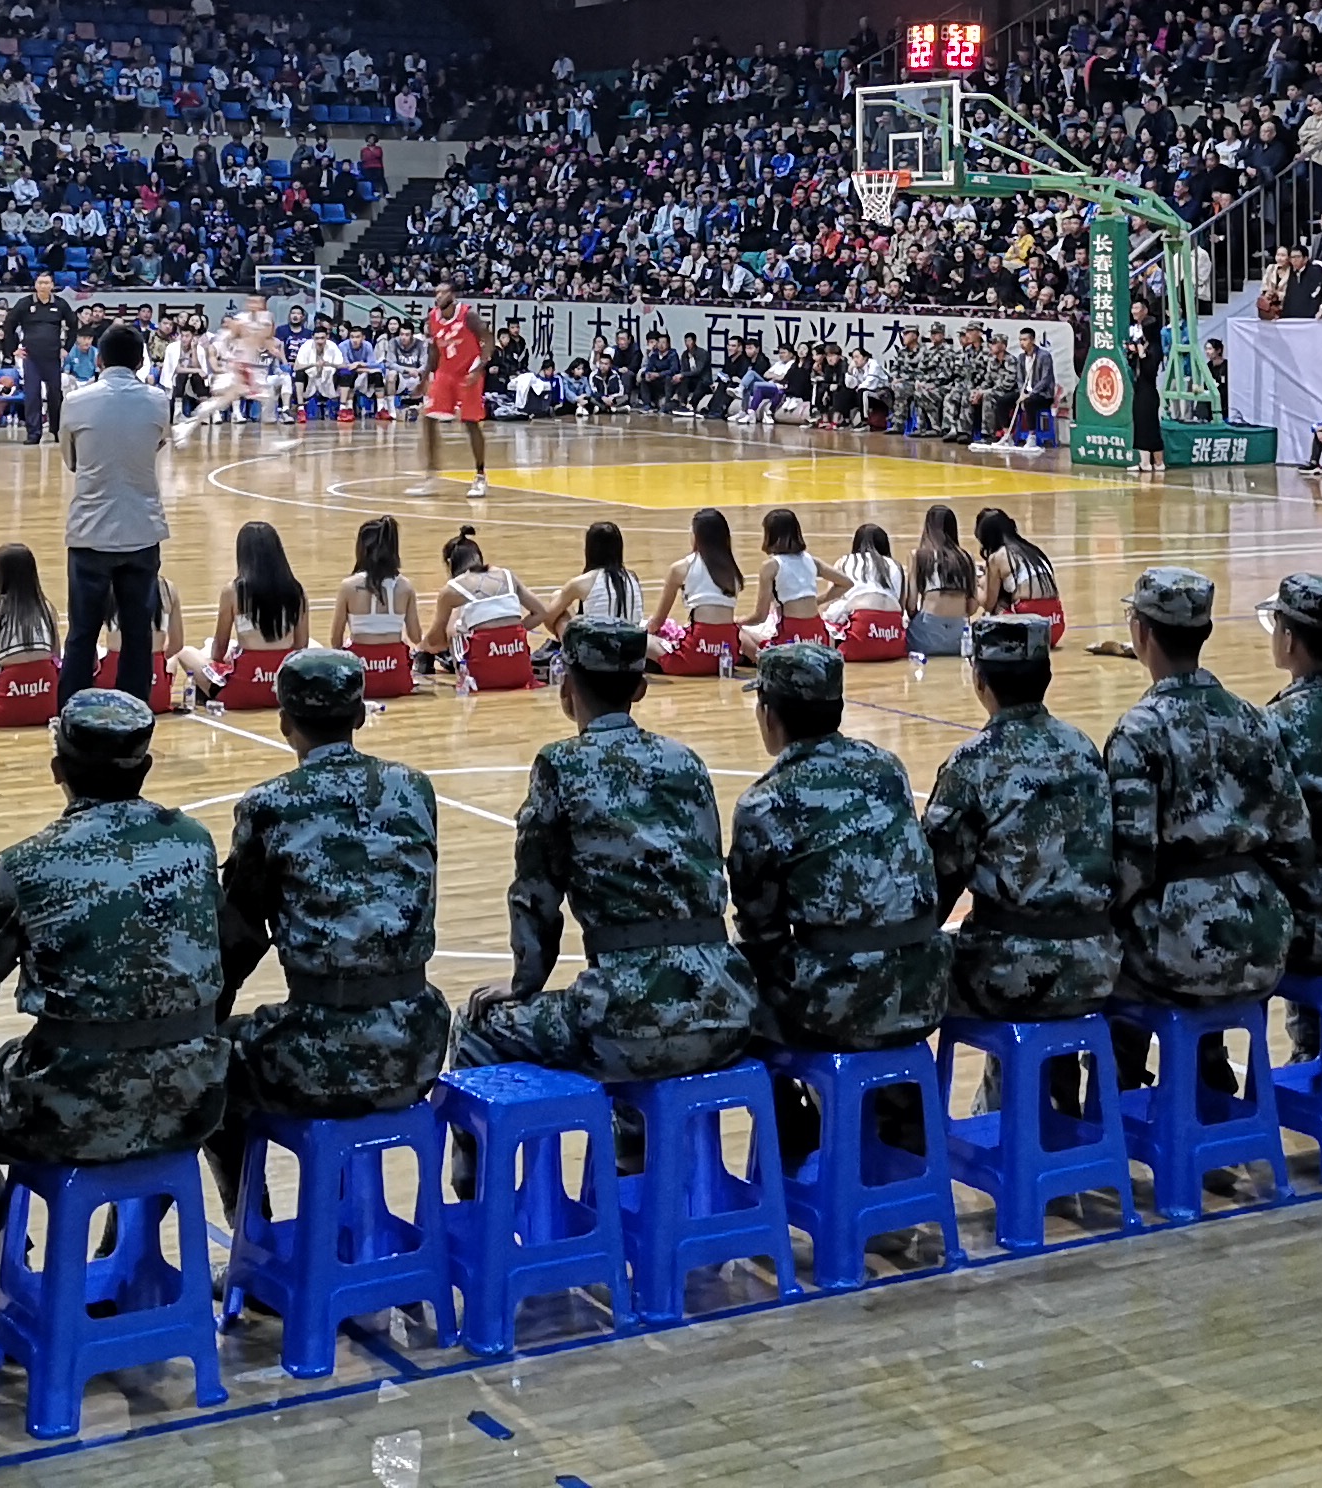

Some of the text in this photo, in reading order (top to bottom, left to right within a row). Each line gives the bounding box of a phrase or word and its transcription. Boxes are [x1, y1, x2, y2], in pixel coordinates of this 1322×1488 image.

[1092, 234, 1114, 349] 长春科技学院
[1191, 438, 1248, 462] 张家港
[868, 622, 899, 642] Angle
[488, 638, 525, 658] Angle
[6, 677, 52, 698] Angle
